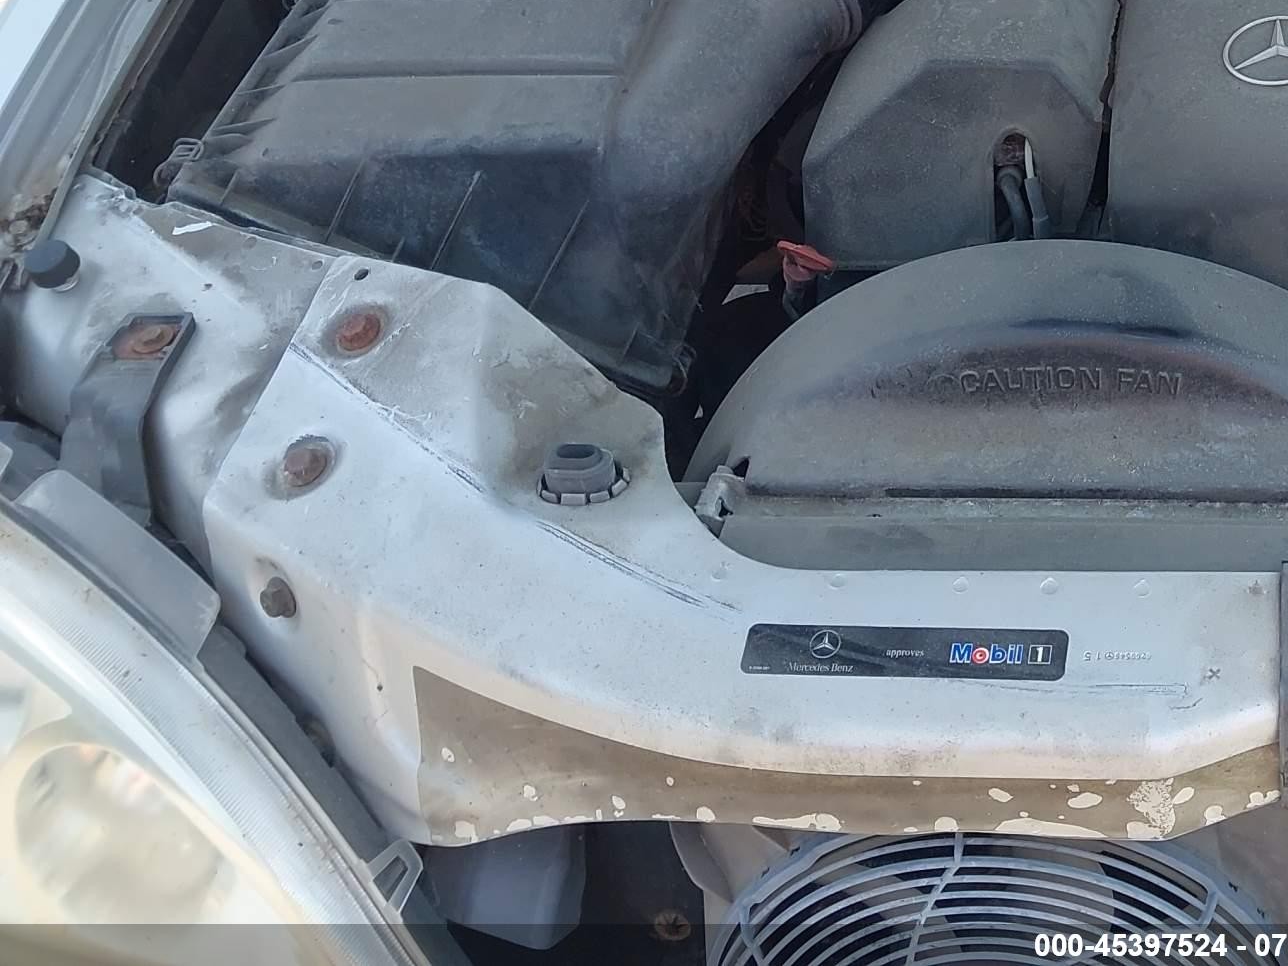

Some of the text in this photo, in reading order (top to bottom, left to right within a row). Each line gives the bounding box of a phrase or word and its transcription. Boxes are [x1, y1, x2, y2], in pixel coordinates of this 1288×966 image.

[959, 365, 1183, 395] CAUTION FAN
[885, 649, 925, 658] approves
[949, 643, 1024, 664] Mobil
[787, 662, 854, 672] Mercedes Benz
